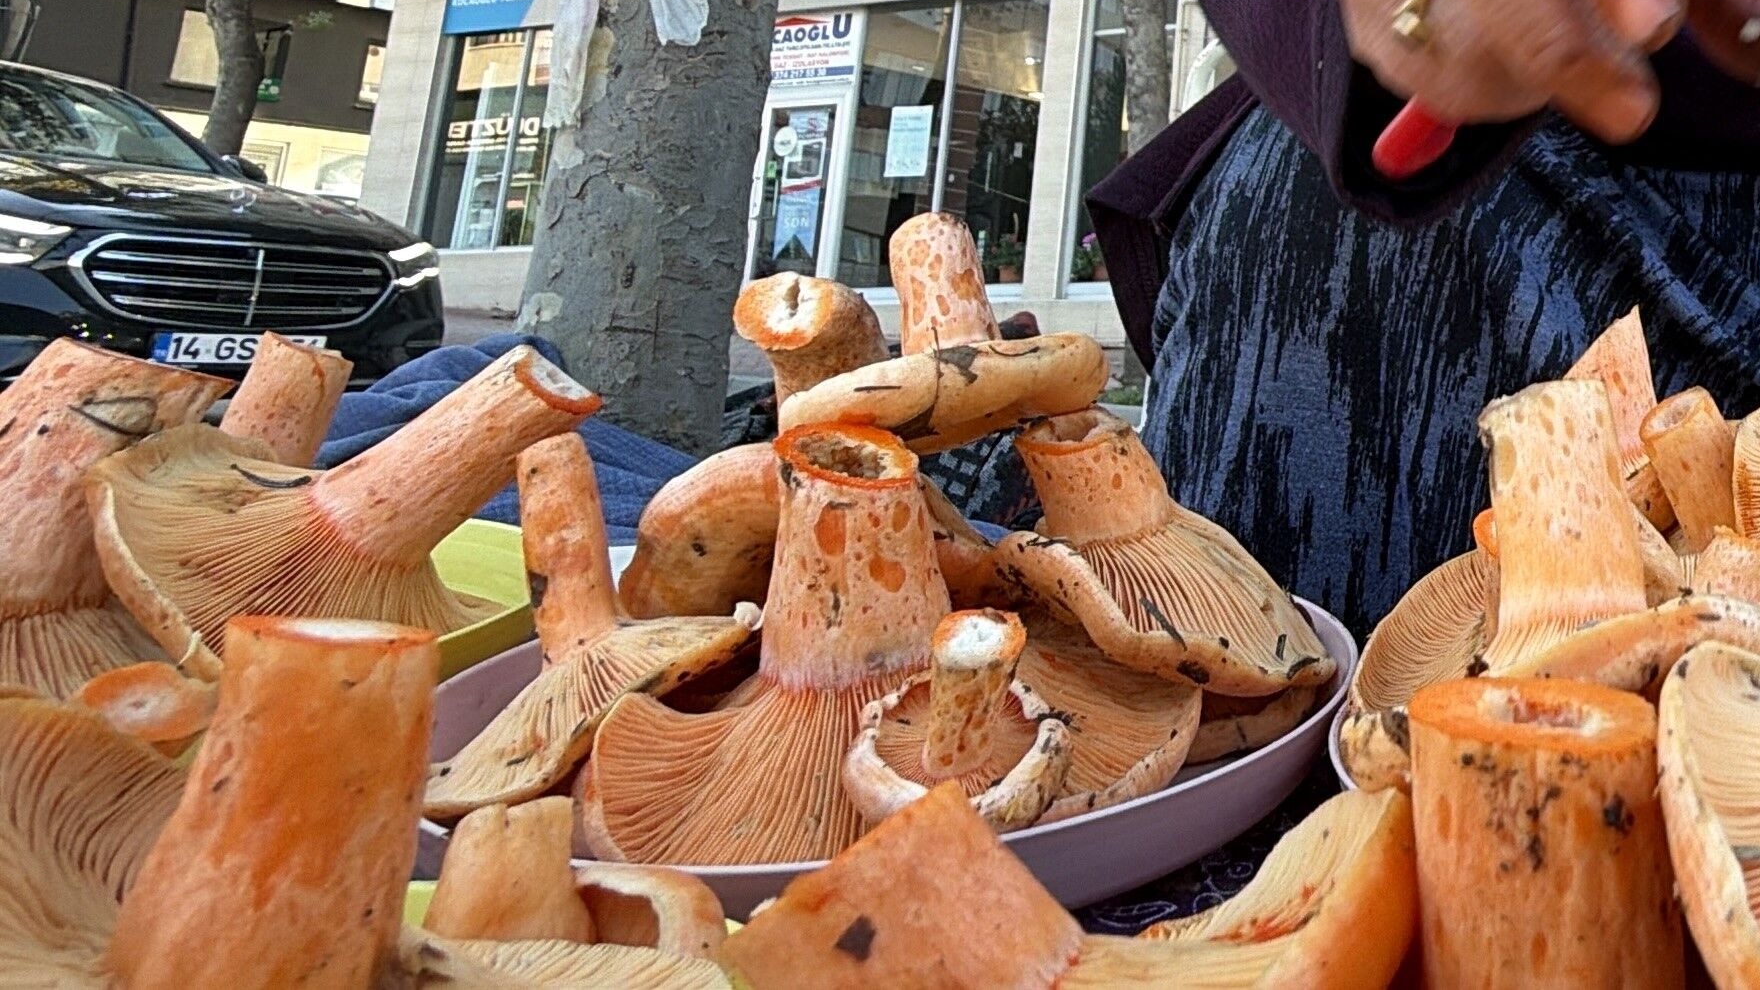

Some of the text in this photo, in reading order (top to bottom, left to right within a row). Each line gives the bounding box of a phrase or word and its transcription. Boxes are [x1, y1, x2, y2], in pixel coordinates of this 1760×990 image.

[773, 13, 853, 44] CAOGLU
[172, 336, 260, 361] 14 GS
